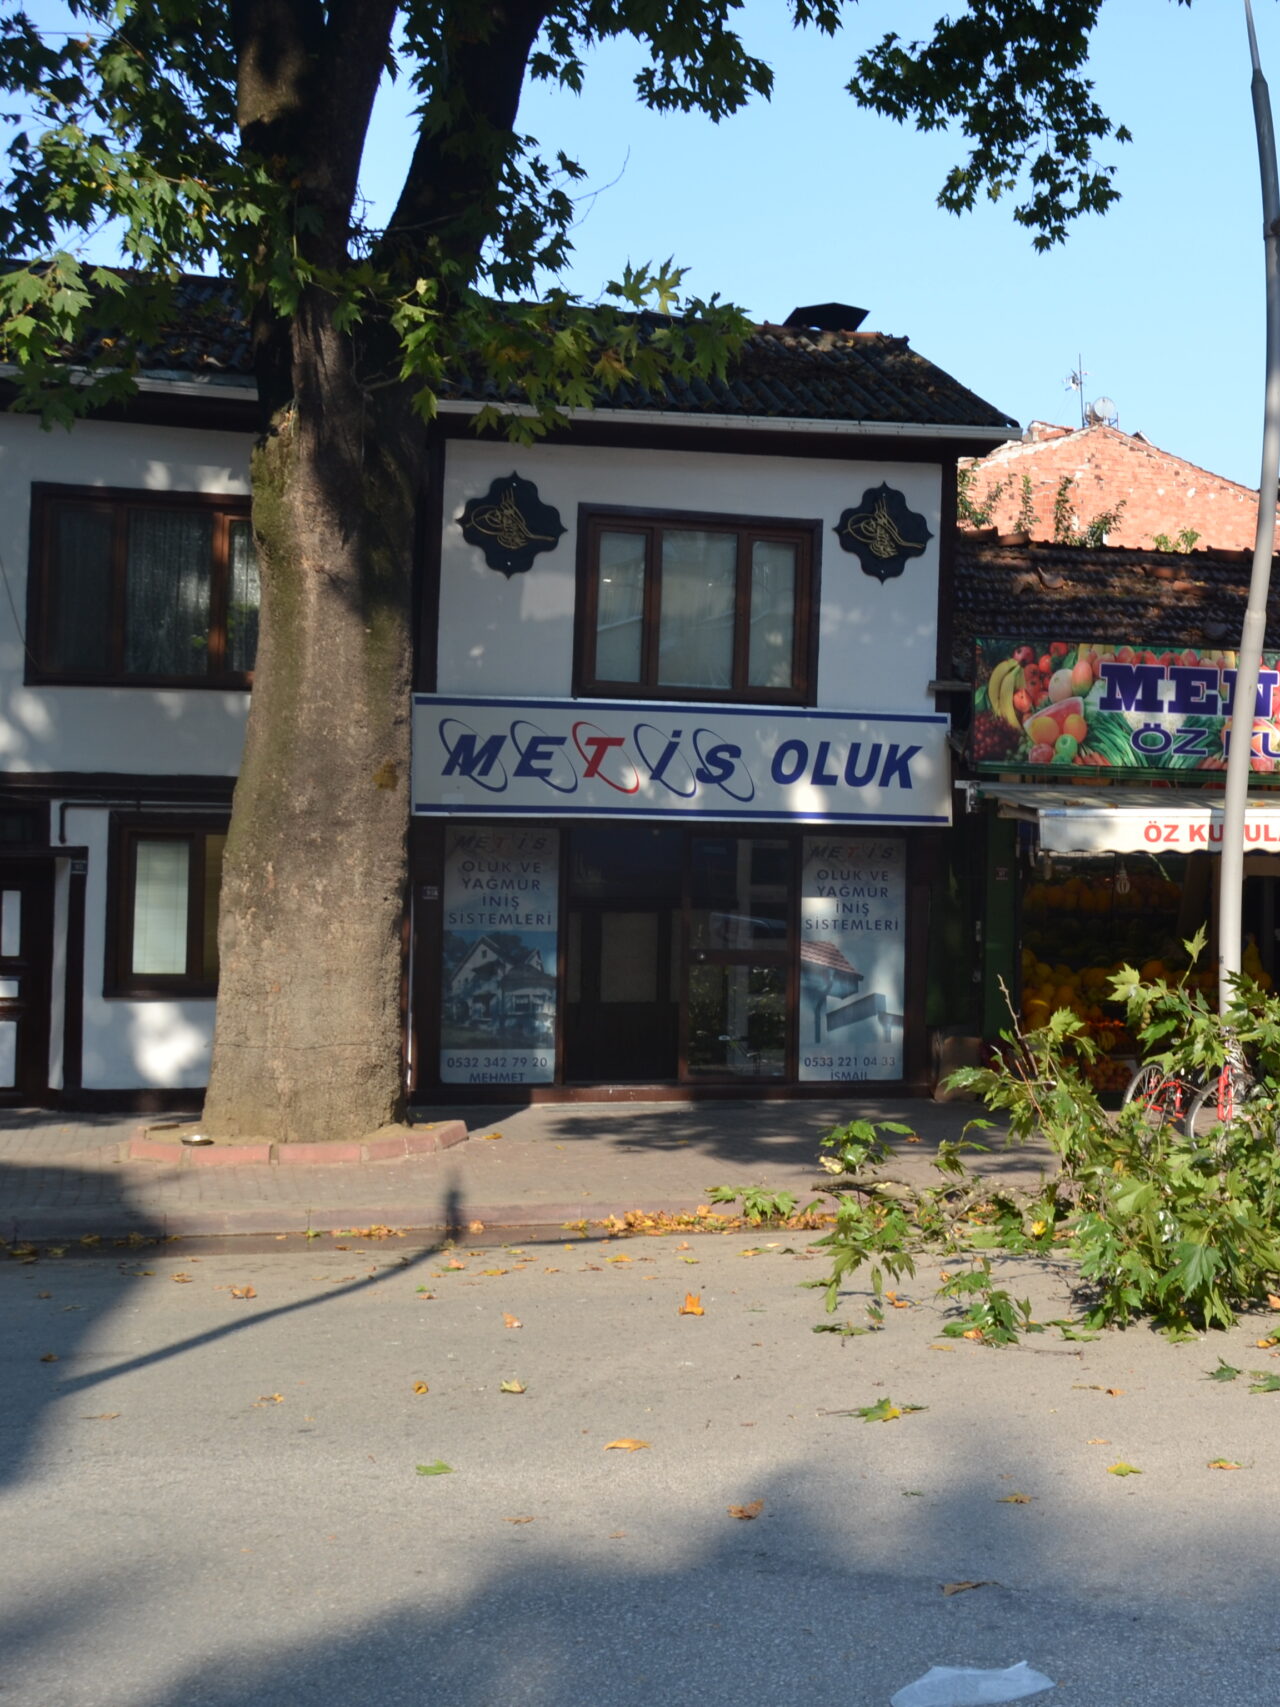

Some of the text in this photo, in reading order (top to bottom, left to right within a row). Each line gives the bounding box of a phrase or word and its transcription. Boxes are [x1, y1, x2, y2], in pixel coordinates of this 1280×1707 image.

[1131, 722, 1209, 756] ÖZ
[771, 738, 923, 790] OLUK
[1143, 820, 1180, 843] ÖZ
[462, 860, 542, 873] OLUK VE
[462, 875, 541, 891] YAĞMUR
[816, 869, 889, 882] OLUK VE
[816, 883, 889, 898] YAĞMUR
[482, 892, 520, 910] İNİŞ
[836, 900, 870, 917] İNİŞ
[448, 910, 553, 926] SİSTEMLERİ
[805, 916, 899, 932] SİSTEMLERİ
[447, 1056, 548, 1068] 0532 342 79 20
[804, 1057, 834, 1068] 0533
[838, 1057, 858, 1067] 221
[863, 1056, 878, 1067] 04
[469, 1073, 526, 1083] MEHMET
